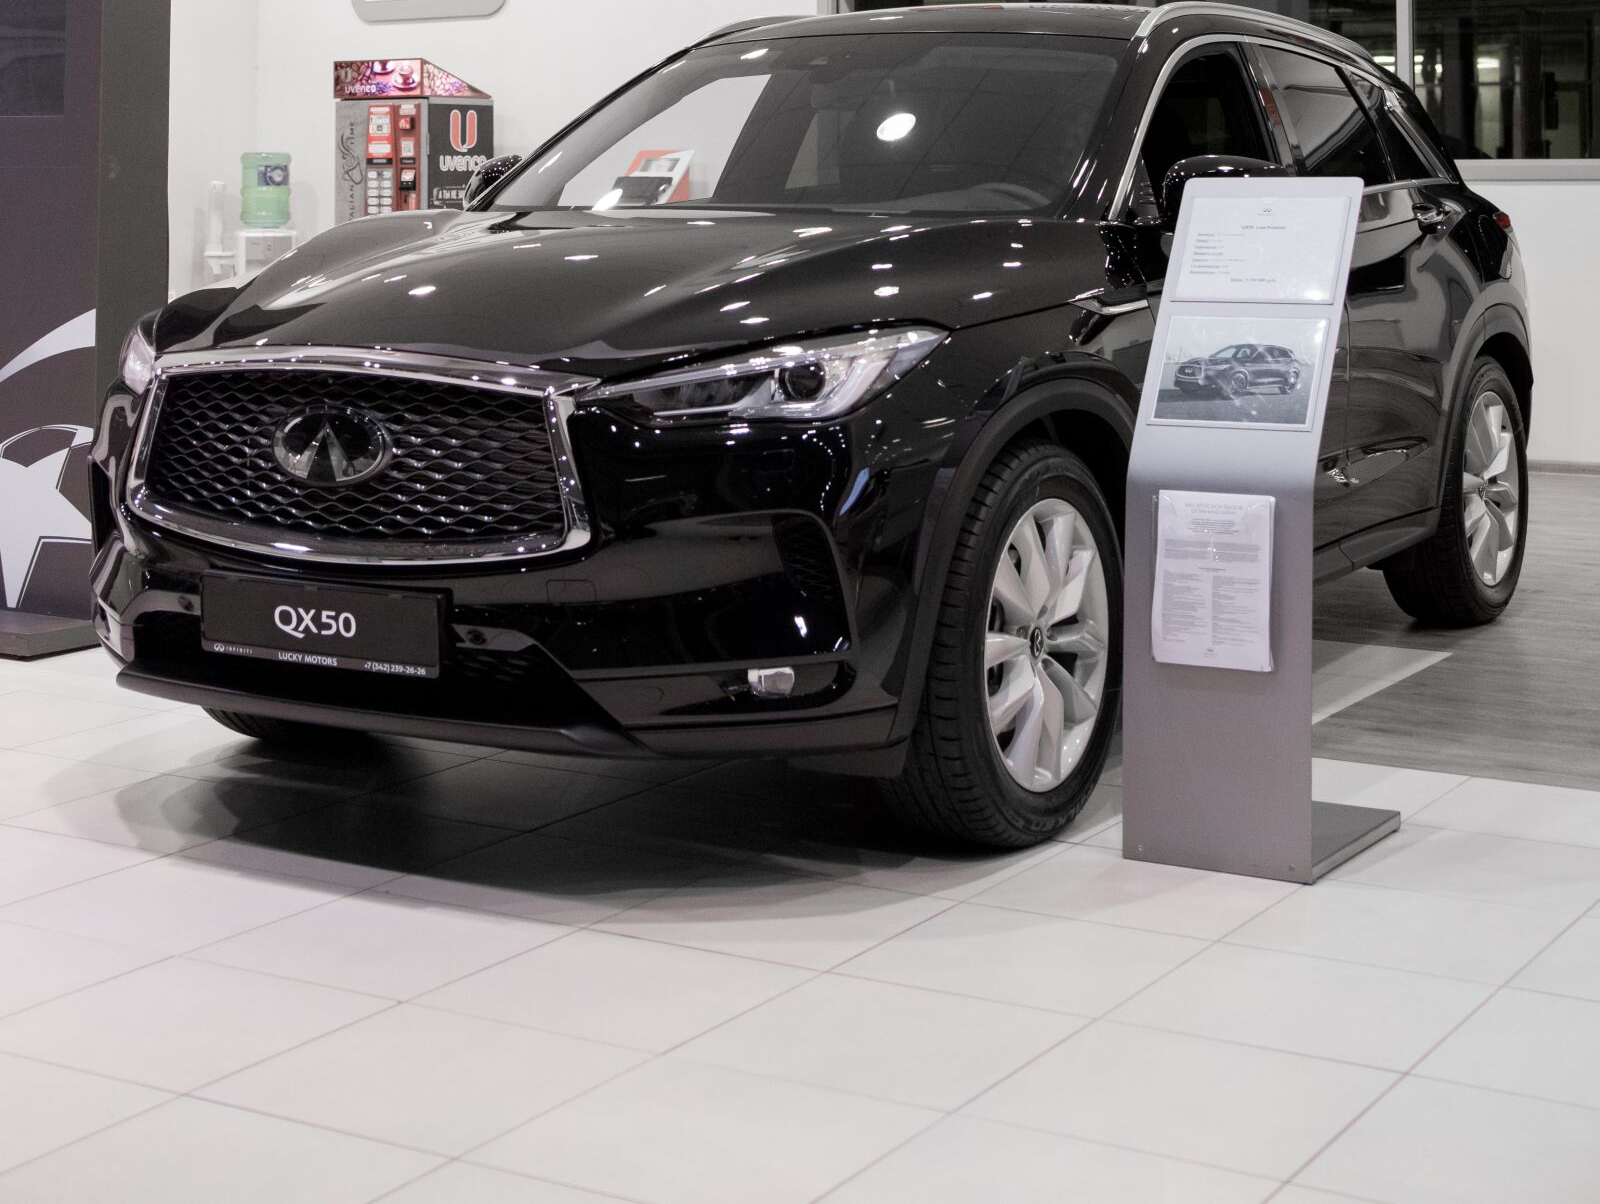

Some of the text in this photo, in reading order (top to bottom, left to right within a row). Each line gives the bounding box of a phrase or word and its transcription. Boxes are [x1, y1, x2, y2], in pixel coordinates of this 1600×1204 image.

[273, 604, 357, 638] QX50
[278, 651, 338, 667] LUCKY MOTORS
[372, 662, 390, 674] (342)
[390, 665, 426, 676] 239-26-26
